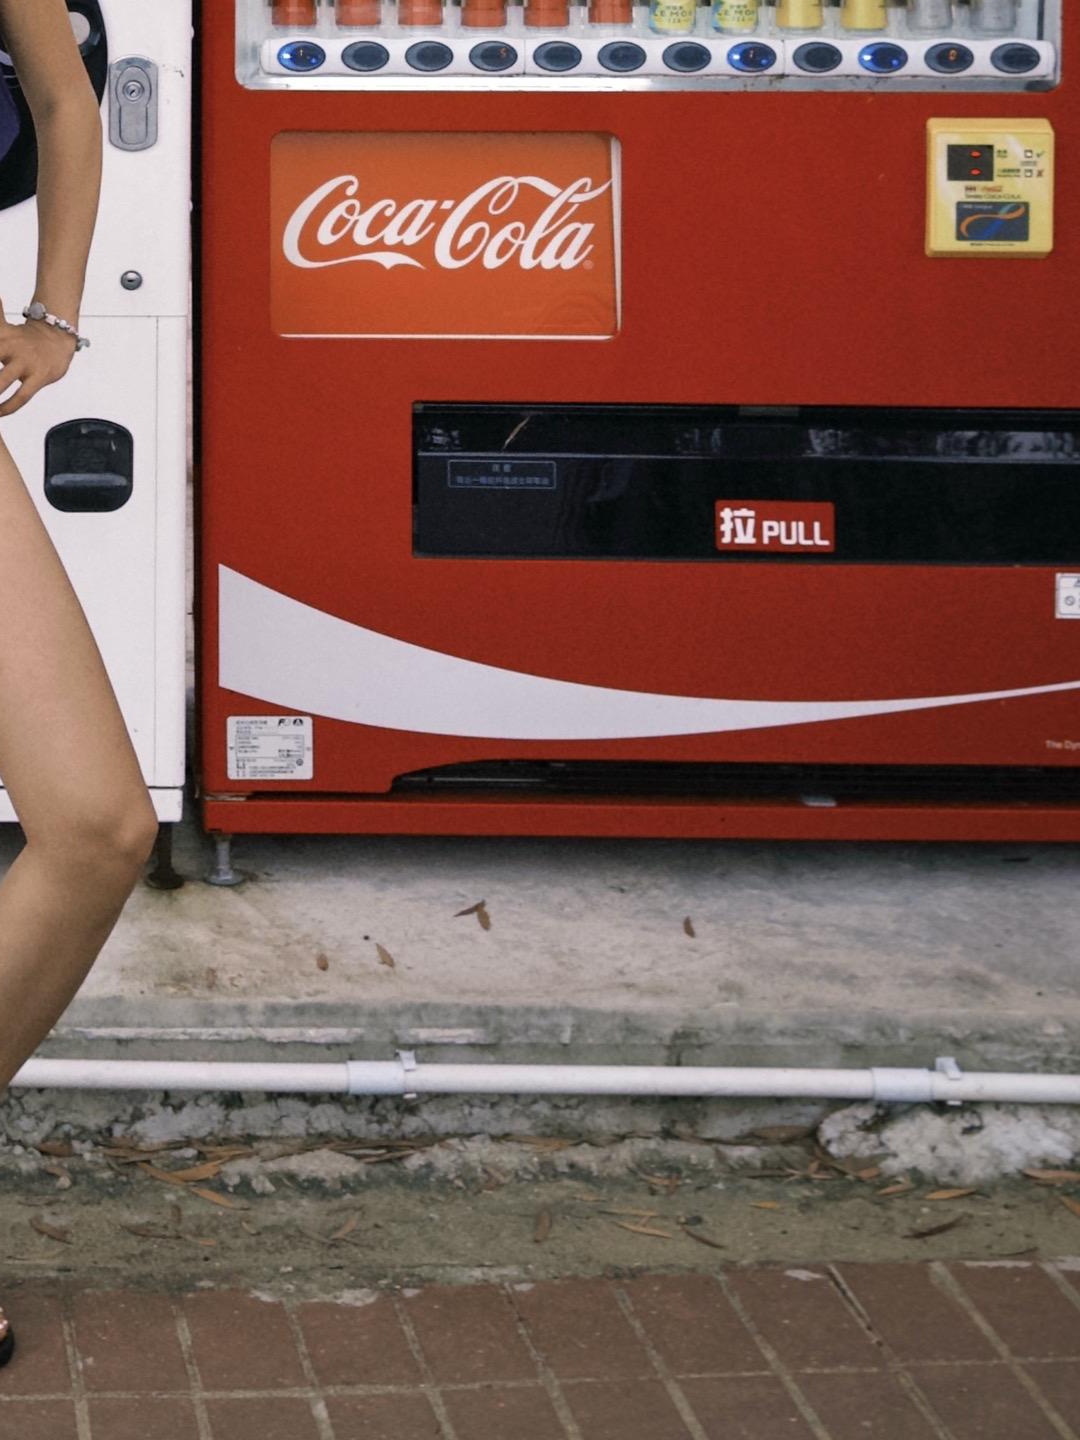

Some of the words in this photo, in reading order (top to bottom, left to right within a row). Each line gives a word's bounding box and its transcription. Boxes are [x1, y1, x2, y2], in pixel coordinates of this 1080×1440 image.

[283, 174, 612, 270] Coca-Cola
[720, 507, 757, 544] 拉
[762, 520, 830, 545] PULL
